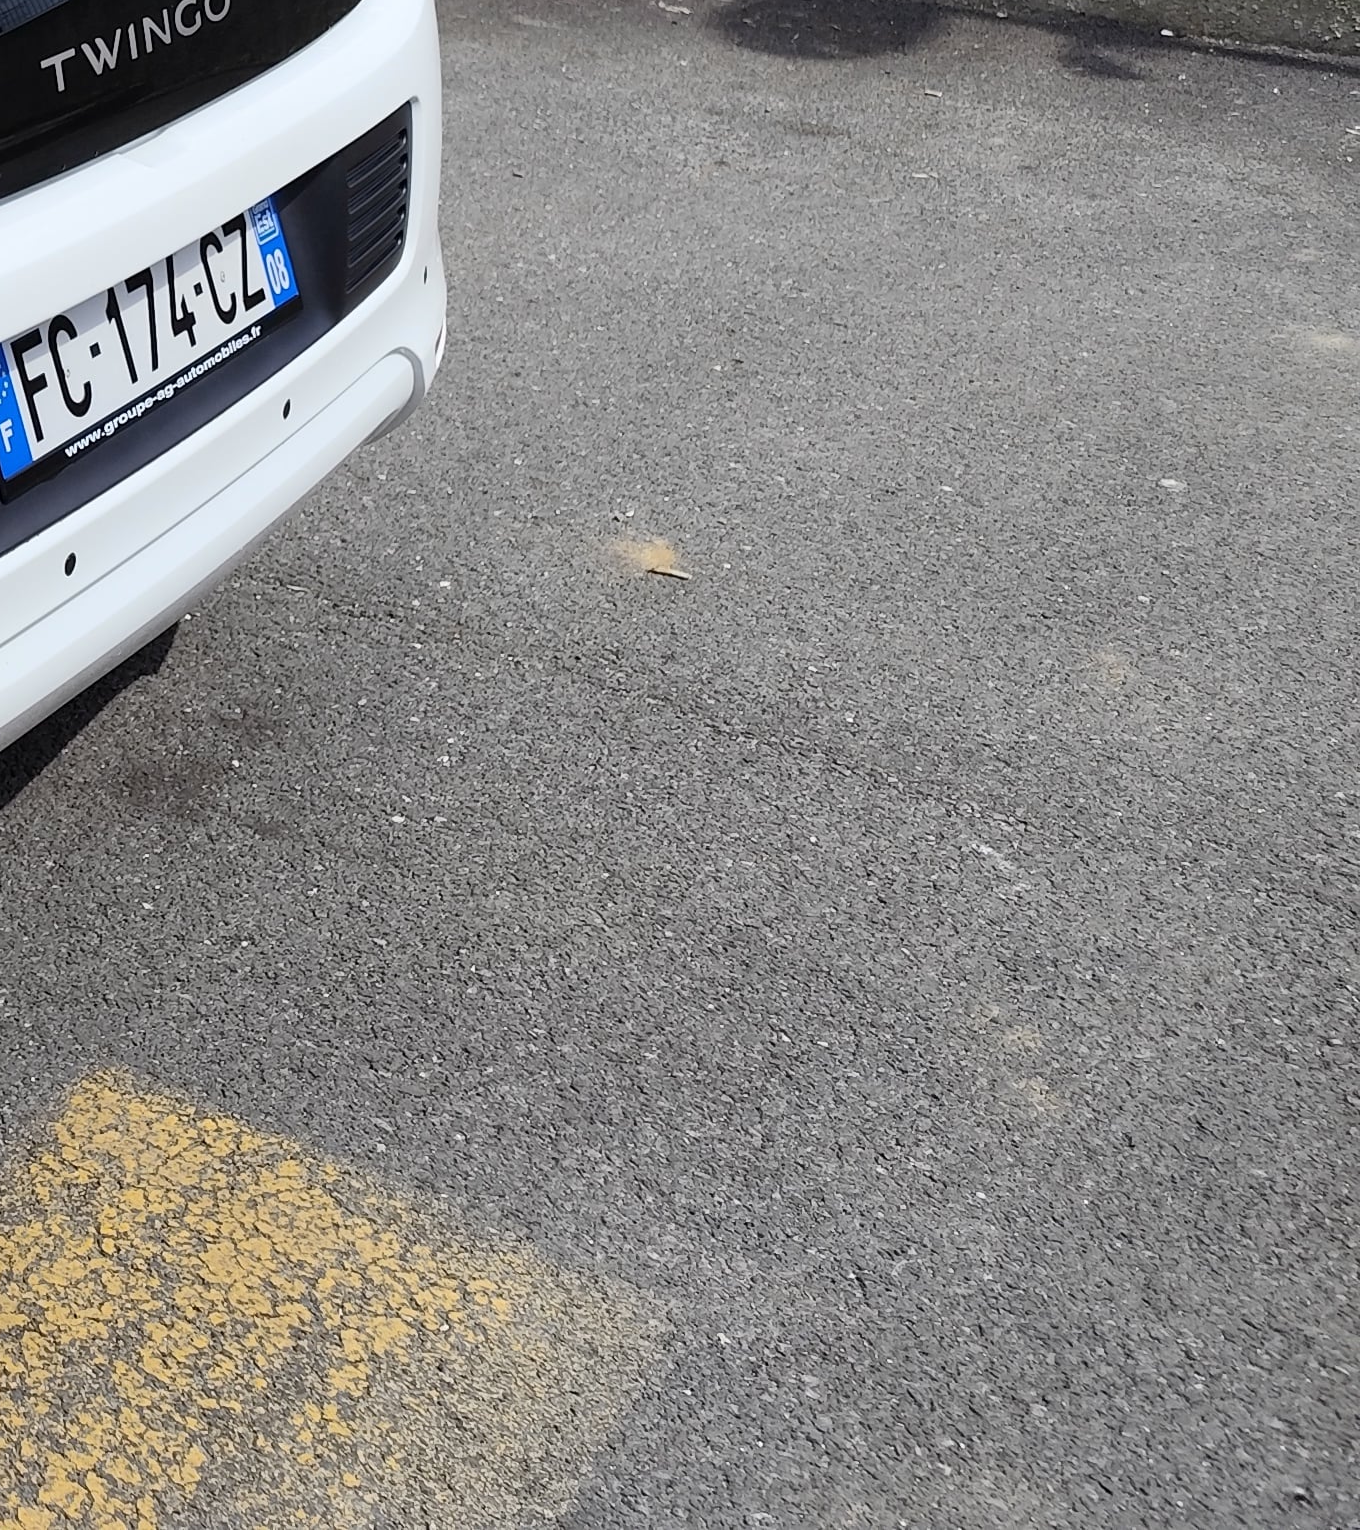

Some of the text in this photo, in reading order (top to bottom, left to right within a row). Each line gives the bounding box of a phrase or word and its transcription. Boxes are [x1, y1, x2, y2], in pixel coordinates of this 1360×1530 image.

[254, 209, 275, 234] Est
[265, 248, 290, 295] 08
[64, 324, 263, 458] www.groupe-ag-automobiles.fr
[0, 418, 14, 454] F
